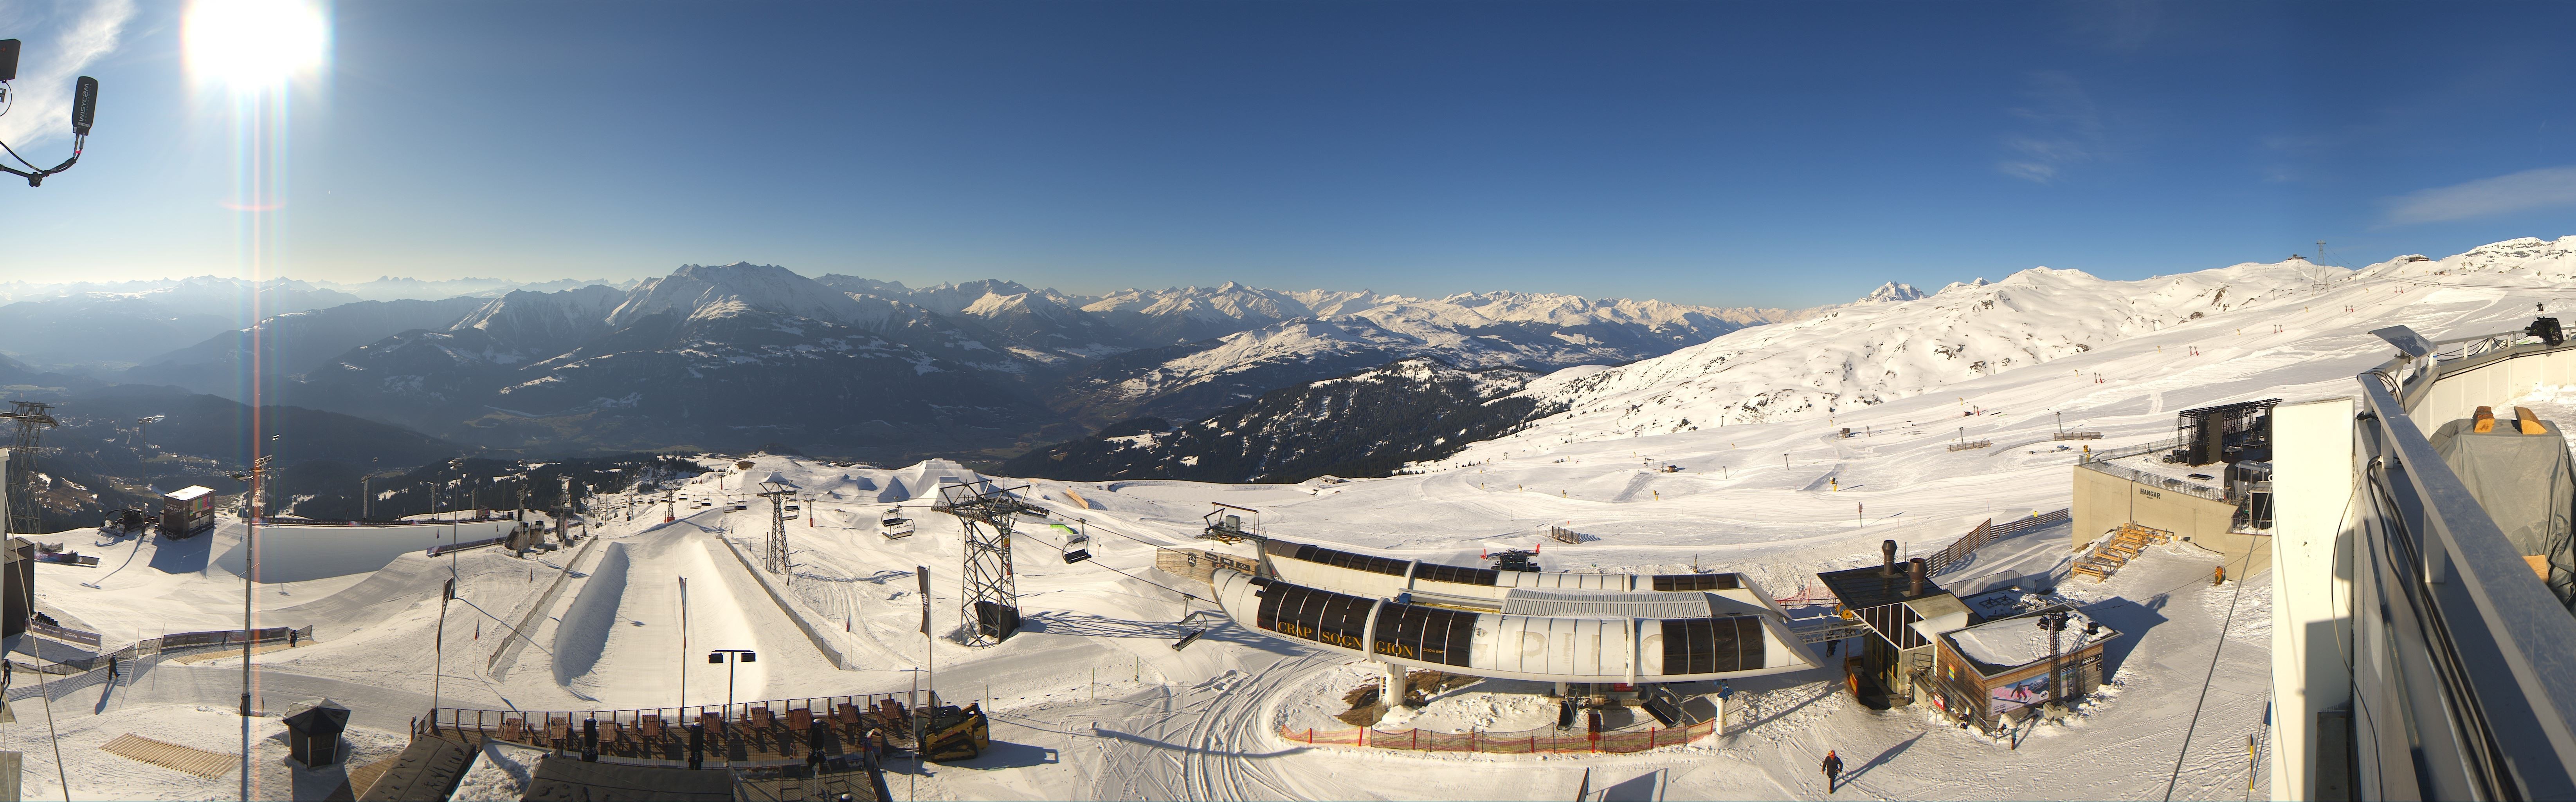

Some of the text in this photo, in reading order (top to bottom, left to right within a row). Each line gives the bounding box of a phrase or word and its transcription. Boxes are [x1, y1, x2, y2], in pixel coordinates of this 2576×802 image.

[79, 83, 89, 121] WISYCOM
[2140, 488, 2160, 499] HANGAR
[1260, 630, 1317, 645] CRUISING ALTITUDE
[1278, 621, 1414, 657] CRAP SOGN GION
